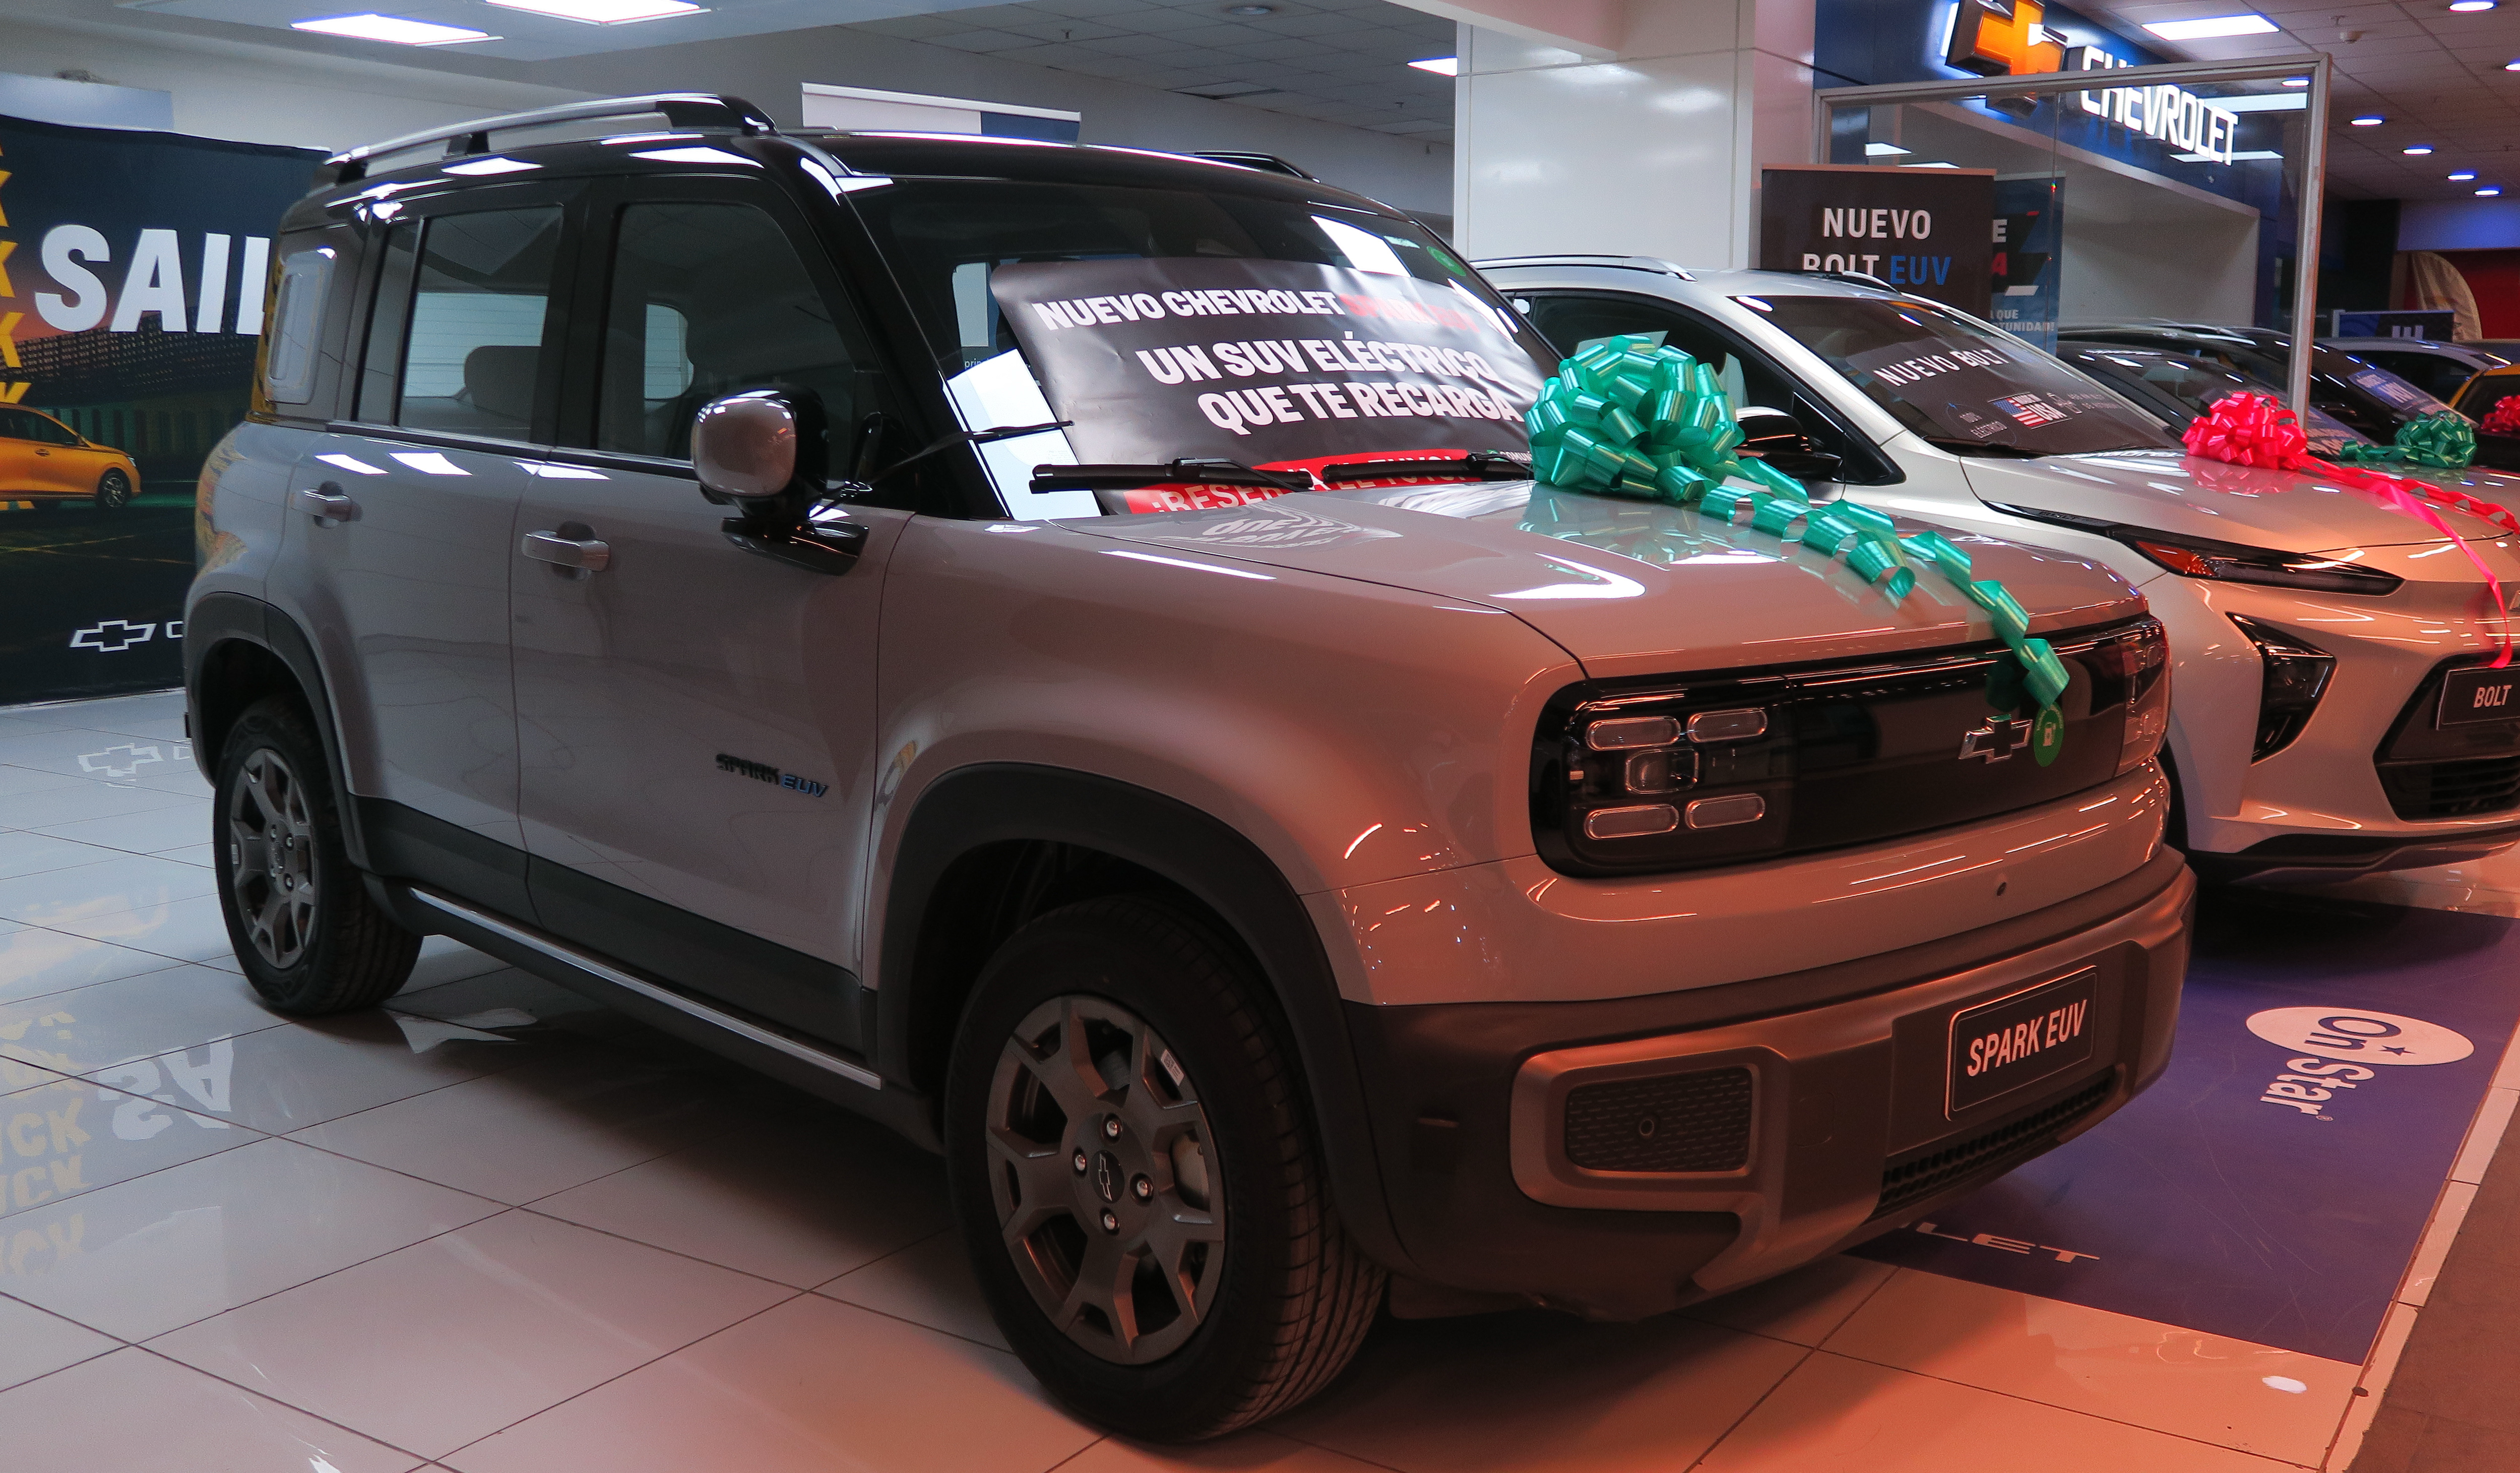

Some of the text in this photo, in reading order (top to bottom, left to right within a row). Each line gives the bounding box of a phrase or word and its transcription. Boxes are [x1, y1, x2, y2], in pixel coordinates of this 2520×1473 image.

[2081, 45, 2238, 166] CHEVROLET
[1823, 208, 1931, 240] NUEVO
[1891, 256, 1951, 285] EUV
[1032, 293, 1165, 331] NUEVO
[1162, 289, 1346, 317] CHEVROLET
[1136, 331, 1500, 385] UN SUV ELÉCTRICO
[1873, 349, 2009, 386] NUEVO BOLT
[1198, 382, 1526, 436] QUE TE RECARGA
[2026, 402, 2067, 421] USA
[2474, 685, 2511, 708] BOLT
[782, 774, 829, 797] EUV
[1967, 1000, 2088, 1077] SPARK EUV
